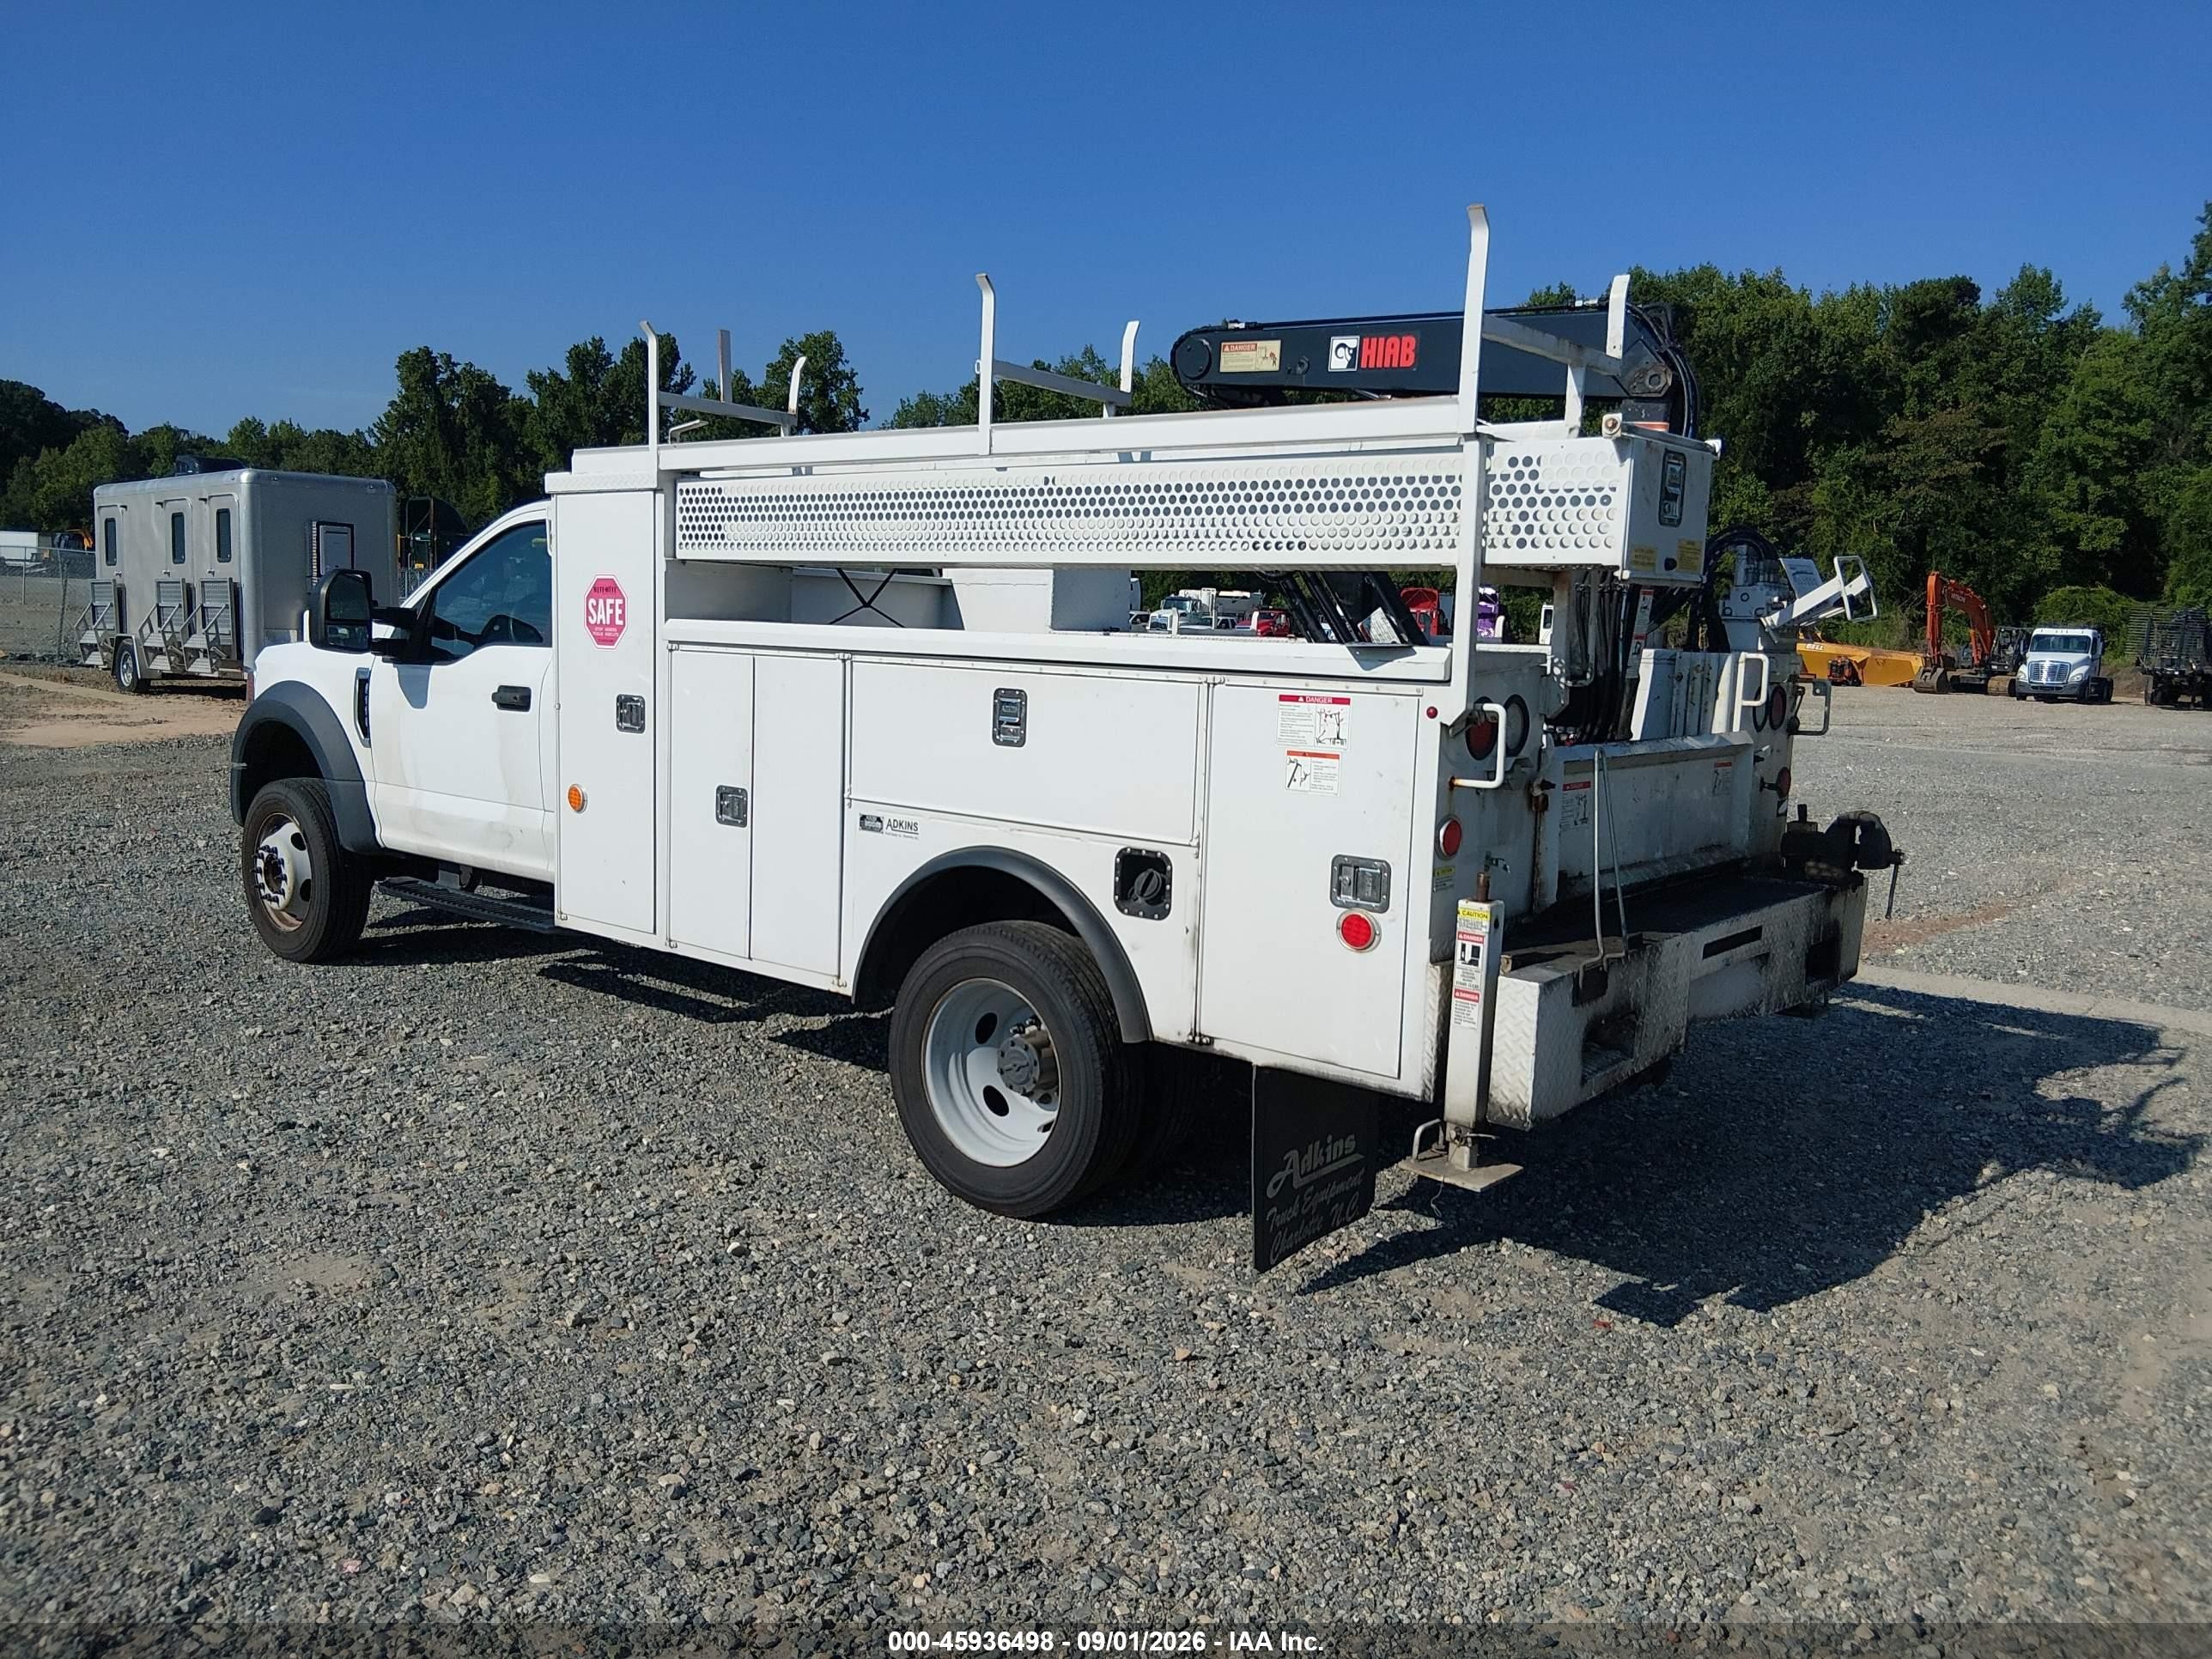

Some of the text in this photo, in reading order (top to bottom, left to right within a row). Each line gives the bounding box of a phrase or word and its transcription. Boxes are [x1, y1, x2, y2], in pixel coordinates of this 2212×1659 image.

[1230, 343, 1255, 352] DANGER
[1360, 335, 1416, 368] HIAB
[588, 598, 624, 625] SAFE
[885, 818, 919, 832] ADKINS
[1462, 910, 1488, 919] CAUTION
[1267, 1134, 1360, 1199] Adkins
[1266, 1167, 1365, 1233] Truck Equipment
[1270, 1215, 1322, 1266] Charlotte
